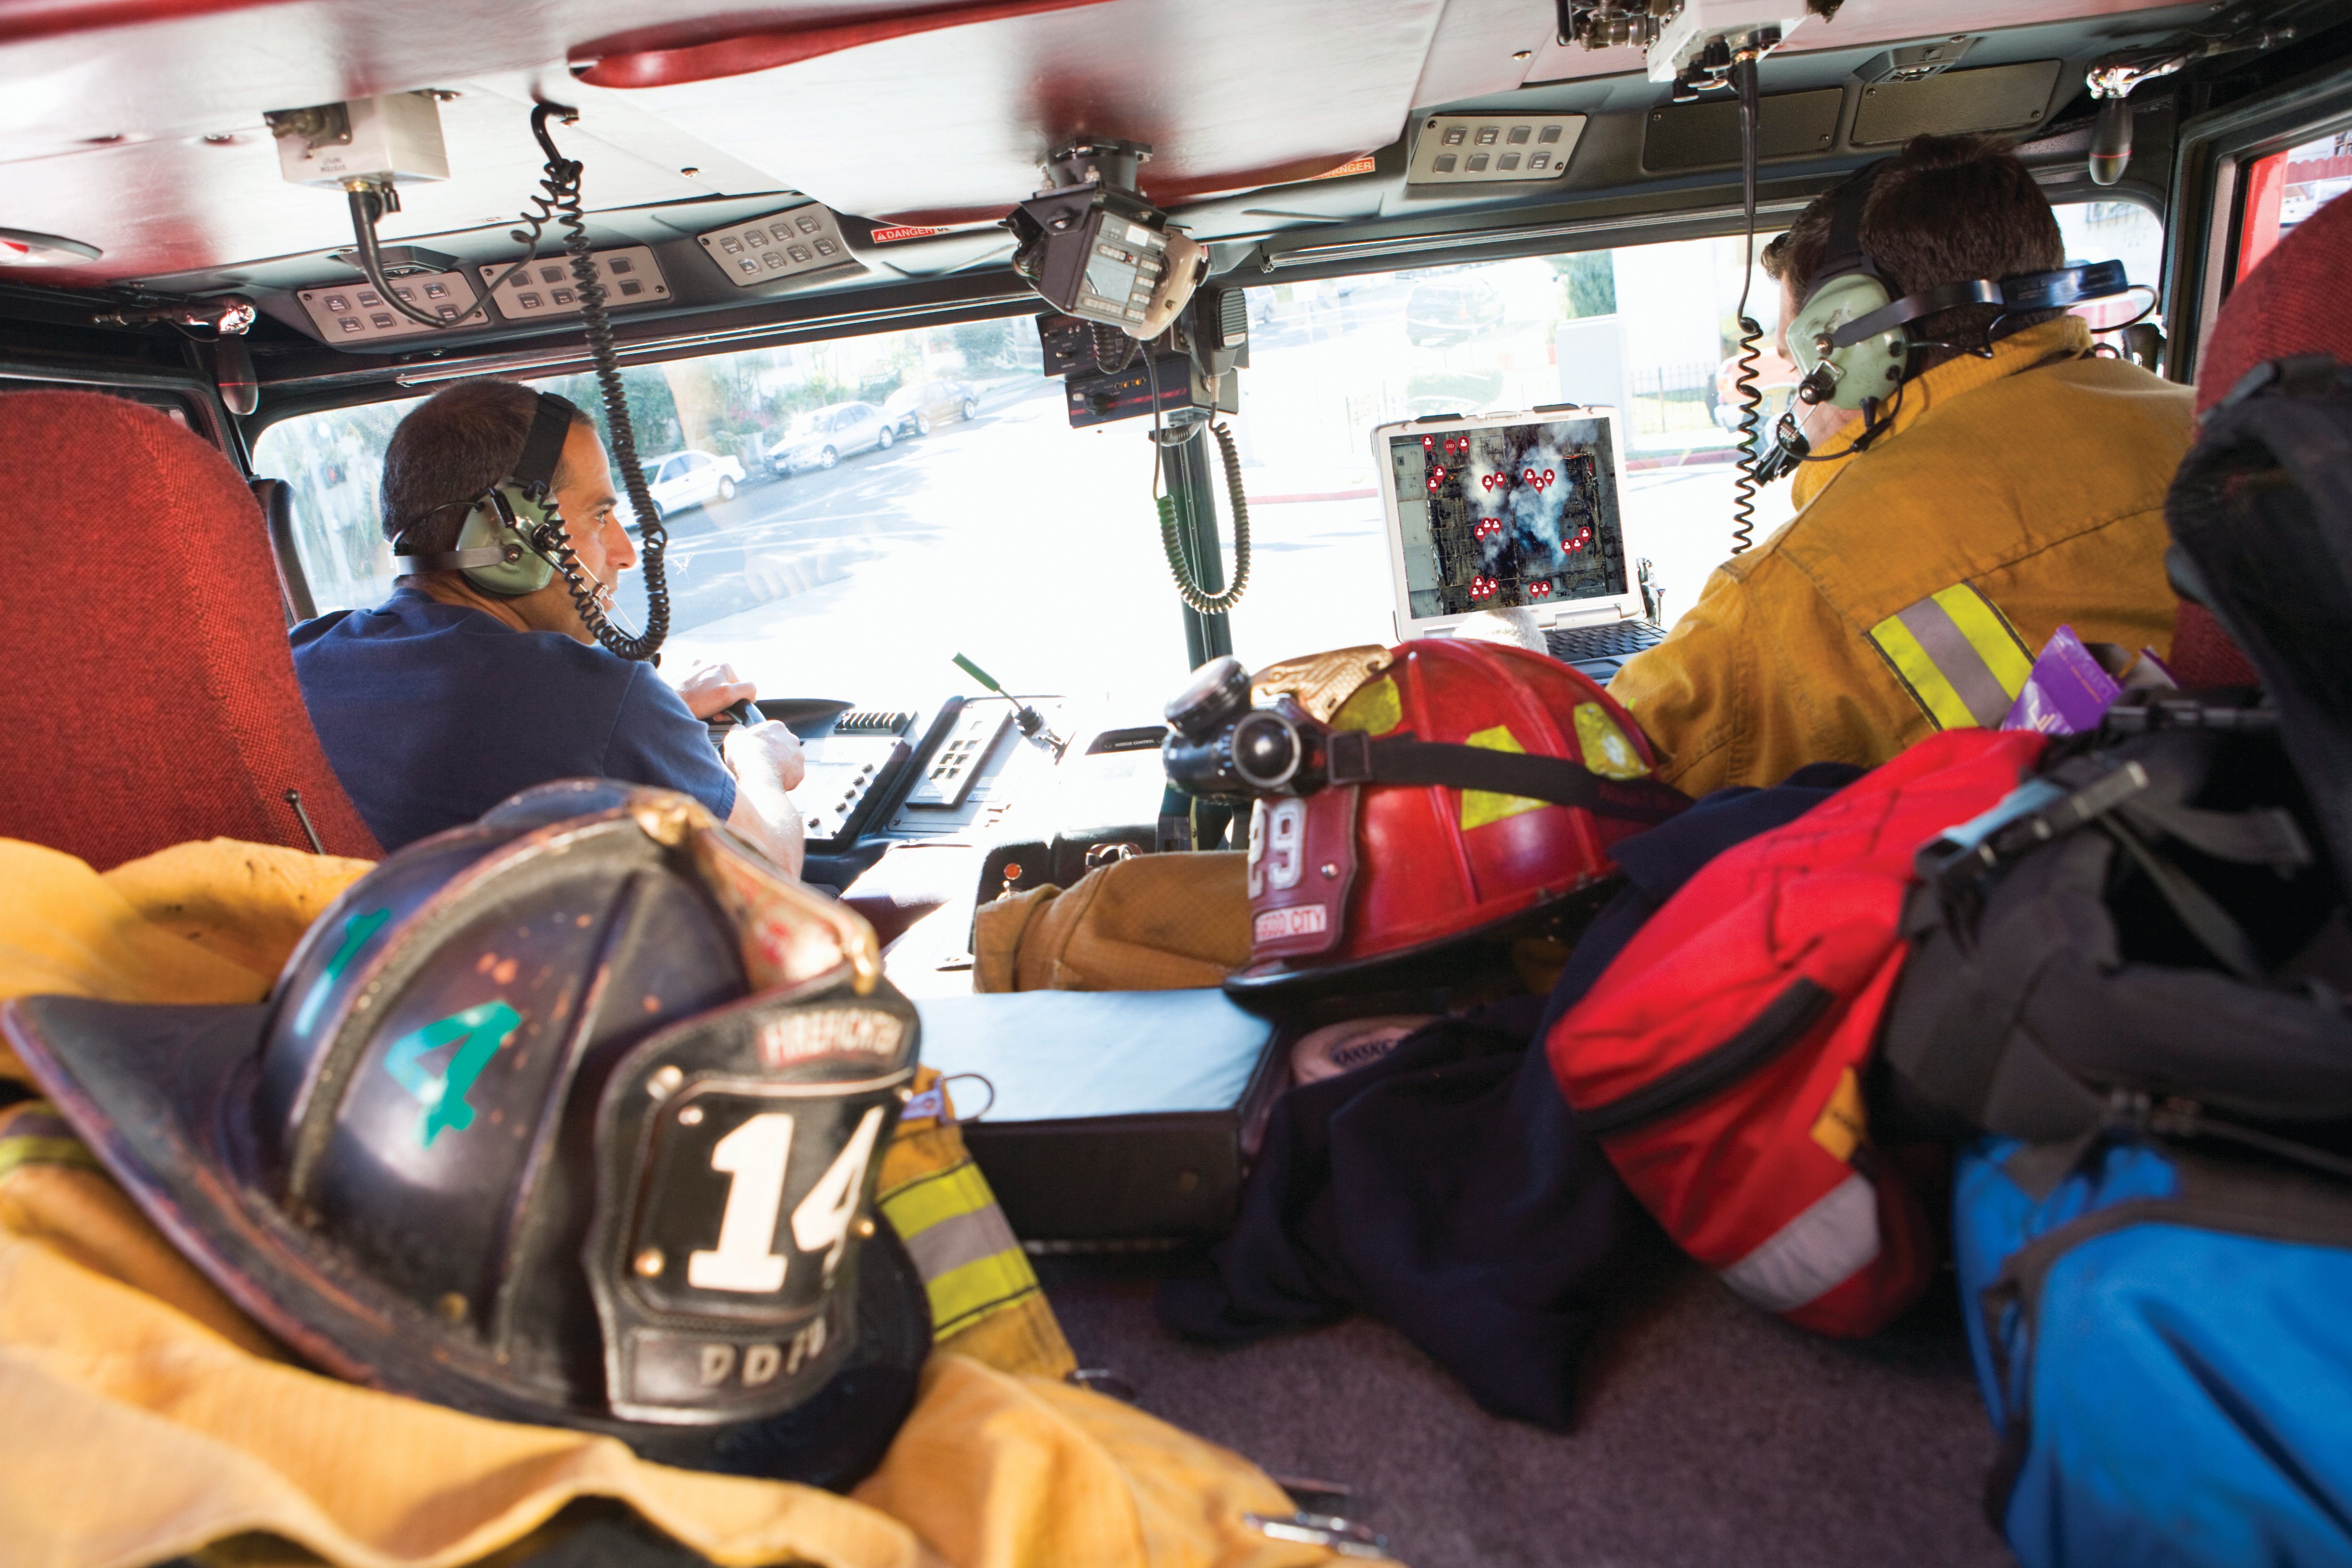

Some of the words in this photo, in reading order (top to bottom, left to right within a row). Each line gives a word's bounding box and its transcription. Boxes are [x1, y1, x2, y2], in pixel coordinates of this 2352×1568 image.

[1330, 162, 1372, 175] ANGER
[886, 228, 933, 239] DANGER
[1290, 909, 1323, 935] CITY
[687, 1105, 885, 1293] 14
